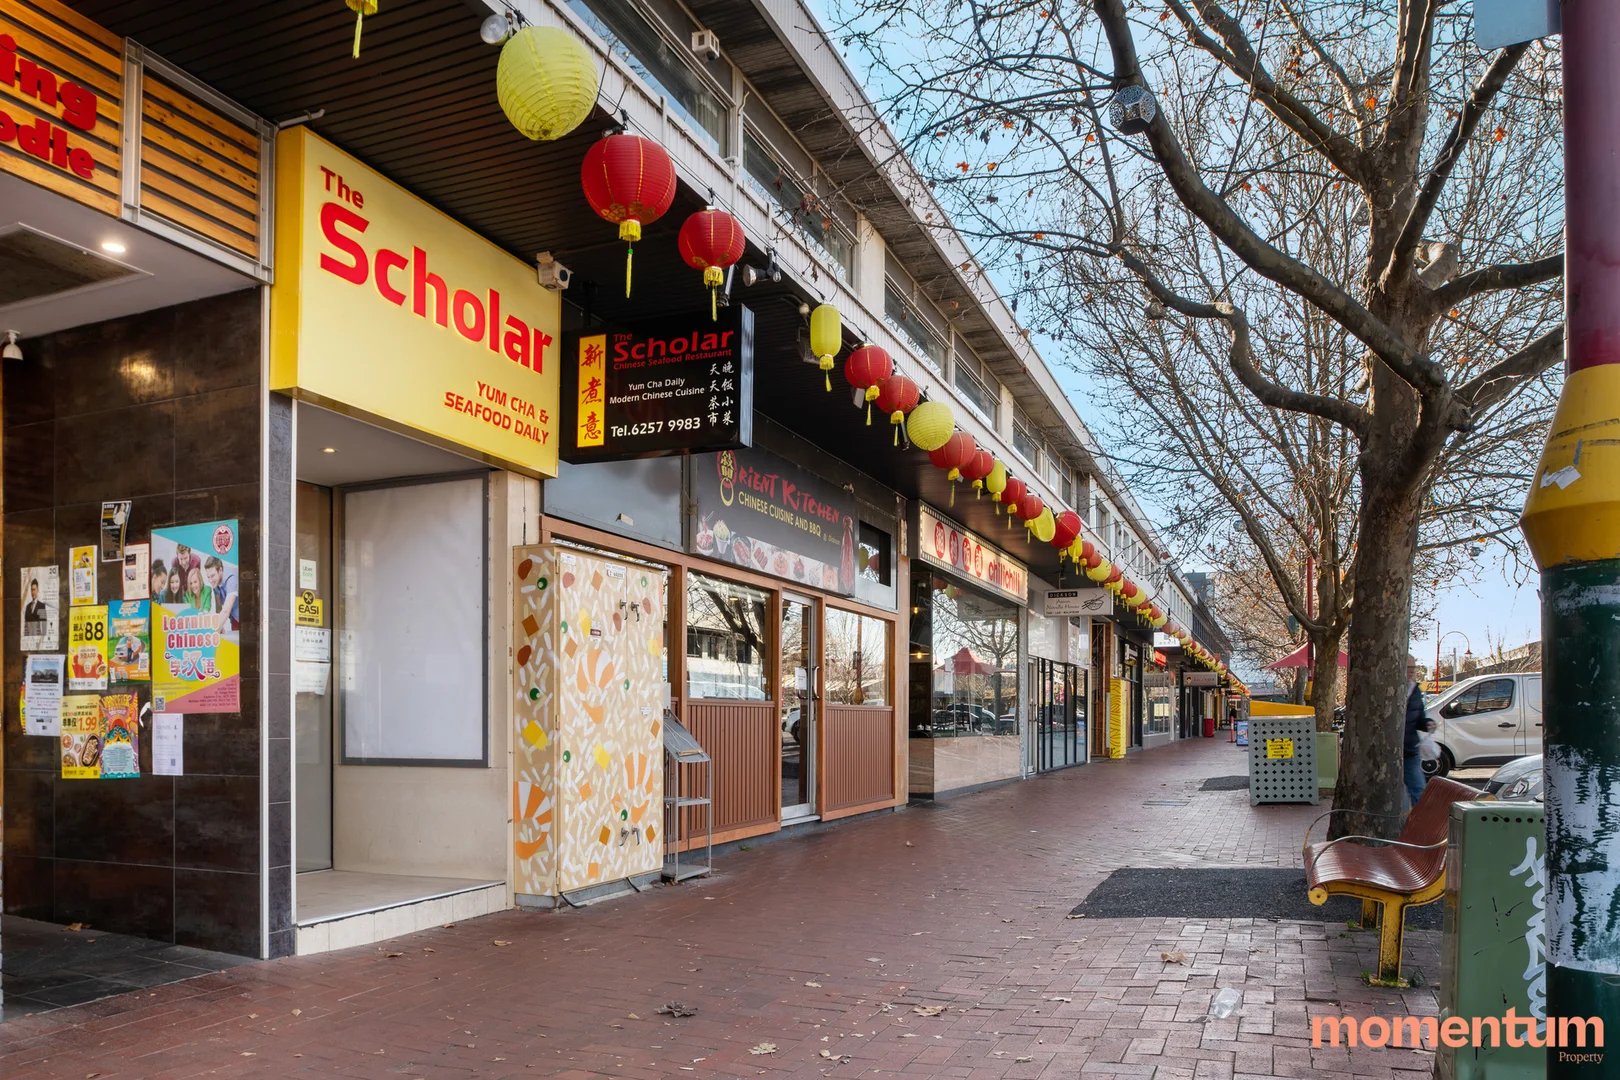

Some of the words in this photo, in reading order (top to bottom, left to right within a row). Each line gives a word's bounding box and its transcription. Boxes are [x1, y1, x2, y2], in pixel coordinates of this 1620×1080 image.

[320, 165, 364, 209] The
[320, 202, 552, 375] Scholar
[613, 333, 633, 342] The
[613, 330, 734, 362] Scholar
[613, 360, 646, 371] Chinese
[648, 354, 682, 366] Seafood
[685, 348, 732, 361] Restaurant
[609, 395, 640, 404] Modern
[641, 390, 673, 401] Chinese
[675, 386, 705, 397] Cuisine
[628, 382, 645, 391] Yum
[646, 380, 663, 389] Cha
[665, 377, 685, 387] Daily
[477, 381, 507, 406] YUM
[510, 397, 535, 420] CHA
[539, 409, 549, 425] &
[444, 391, 511, 430] SEAFOOD
[514, 420, 549, 445] DAILY
[611, 421, 663, 437] Tel.6257
[668, 417, 701, 431] 9983
[738, 491, 768, 515] CHINESE
[769, 504, 794, 526] CUISINE
[794, 516, 809, 531] AND
[809, 522, 821, 537] BBQ
[298, 604, 319, 615] EASI
[162, 612, 220, 632] Learning
[167, 631, 221, 649] Chinese
[170, 650, 216, 680] 学汉语
